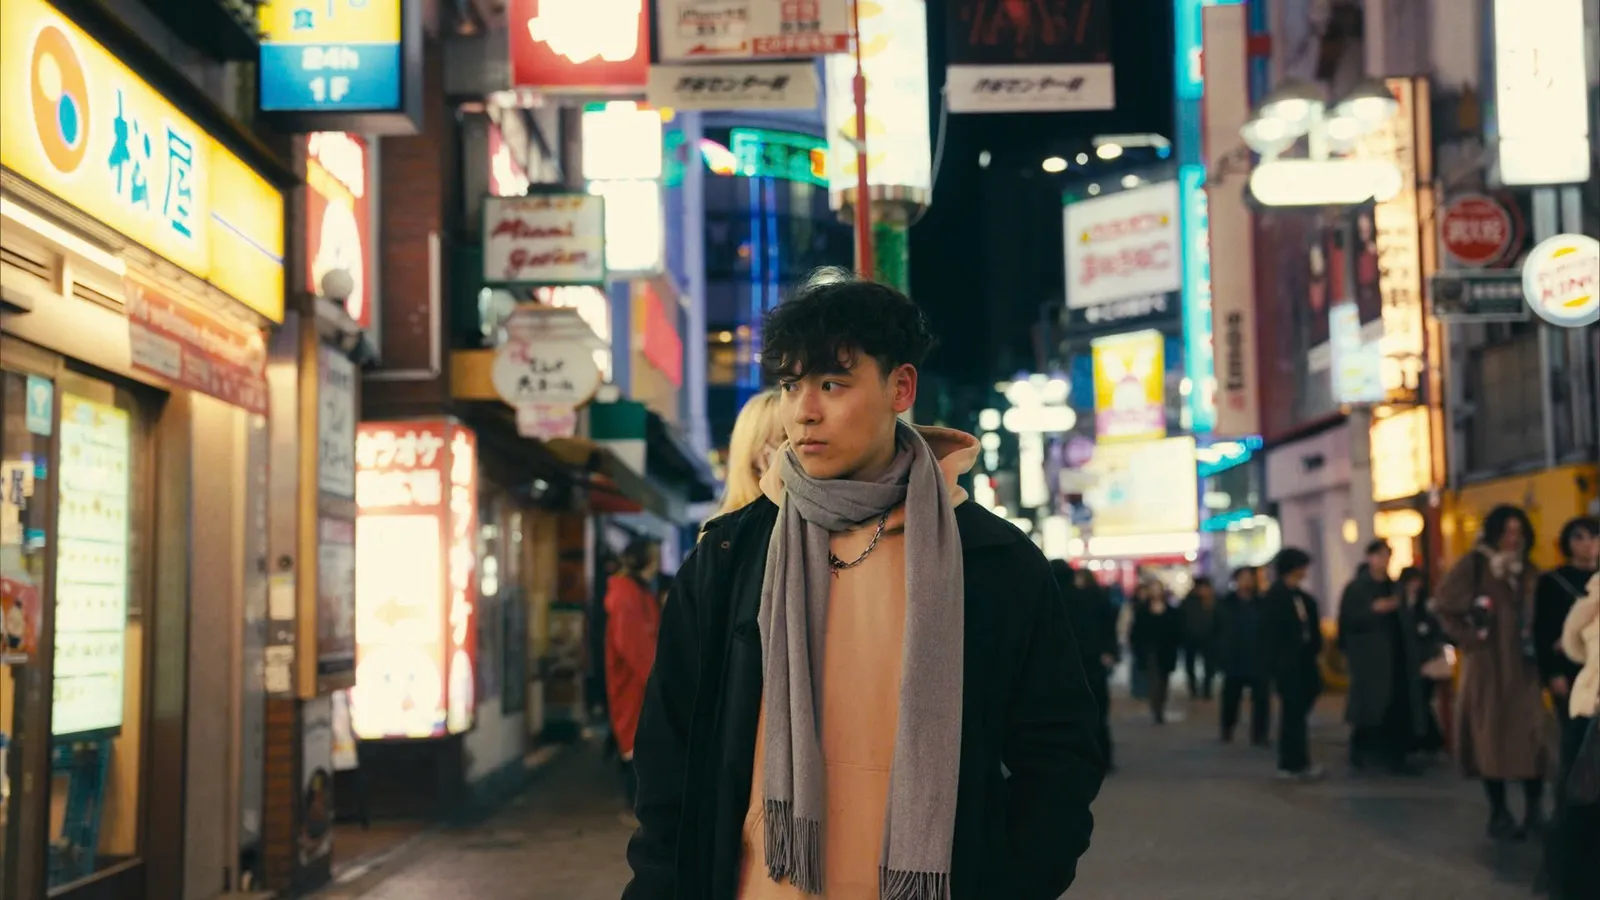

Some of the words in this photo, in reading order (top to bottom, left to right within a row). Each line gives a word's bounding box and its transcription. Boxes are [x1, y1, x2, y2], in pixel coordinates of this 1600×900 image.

[309, 76, 349, 103] 1F
[108, 89, 192, 239] 松屋
[356, 429, 445, 468] カラオケ
